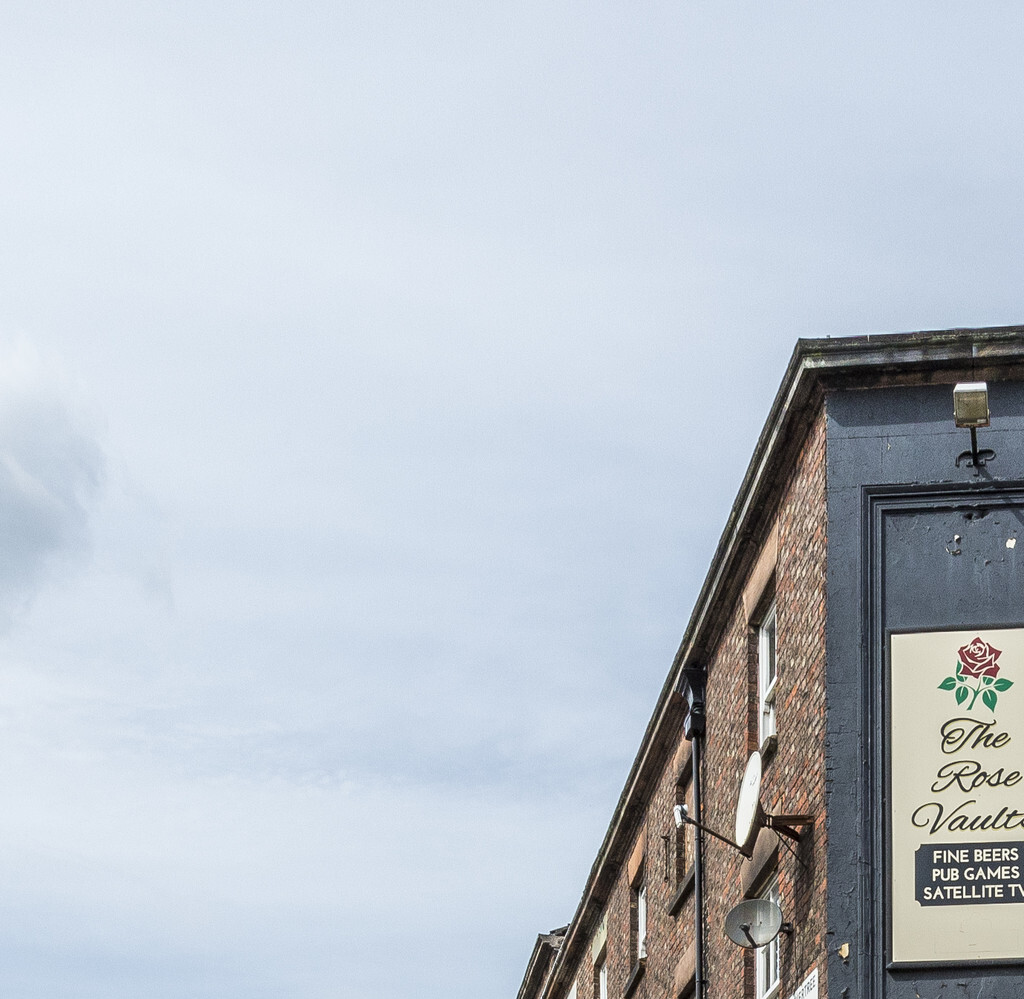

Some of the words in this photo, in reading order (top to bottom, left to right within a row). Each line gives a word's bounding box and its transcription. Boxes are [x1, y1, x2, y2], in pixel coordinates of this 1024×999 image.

[940, 717, 1011, 754] The
[931, 760, 1023, 794] Rose
[933, 850, 968, 864] FINE
[974, 848, 1019, 862] BEERS
[932, 868, 960, 882] PUB
[964, 866, 1020, 882] GAMES
[923, 884, 1004, 900] SATELLITE
